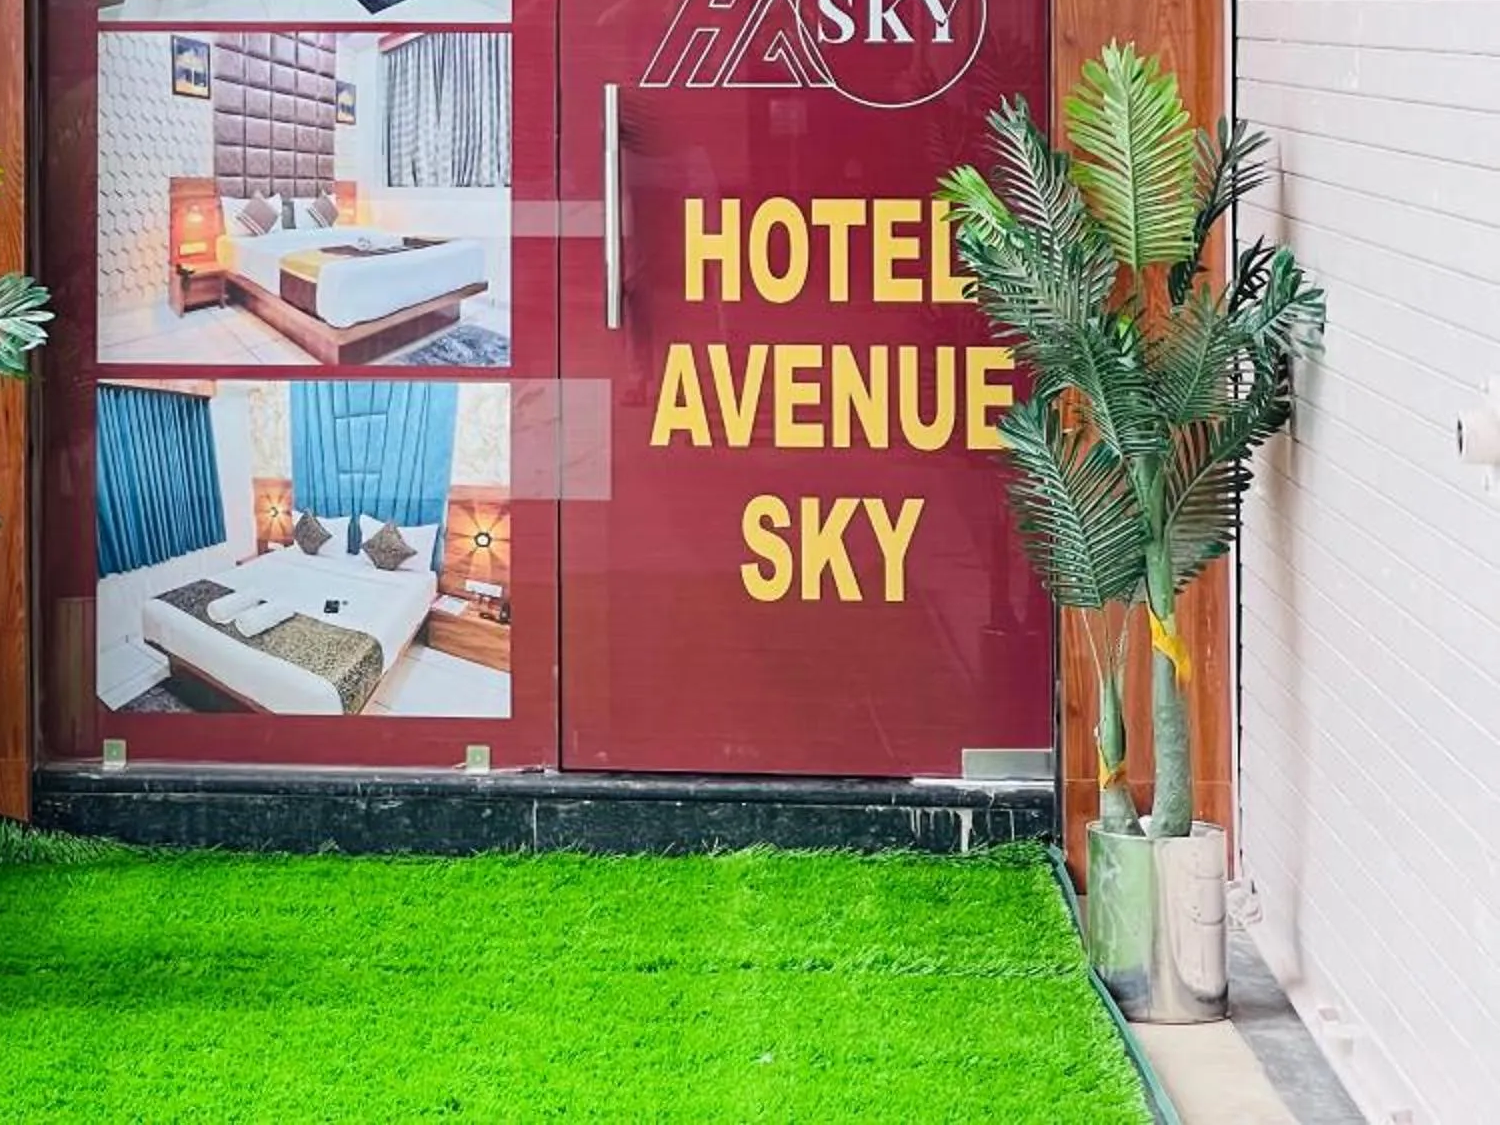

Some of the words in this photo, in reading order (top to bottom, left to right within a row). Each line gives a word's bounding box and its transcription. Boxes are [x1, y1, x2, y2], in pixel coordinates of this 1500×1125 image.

[684, 197, 979, 304] HOTEL
[650, 344, 1016, 452] AVENUE
[740, 494, 925, 603] SKY
